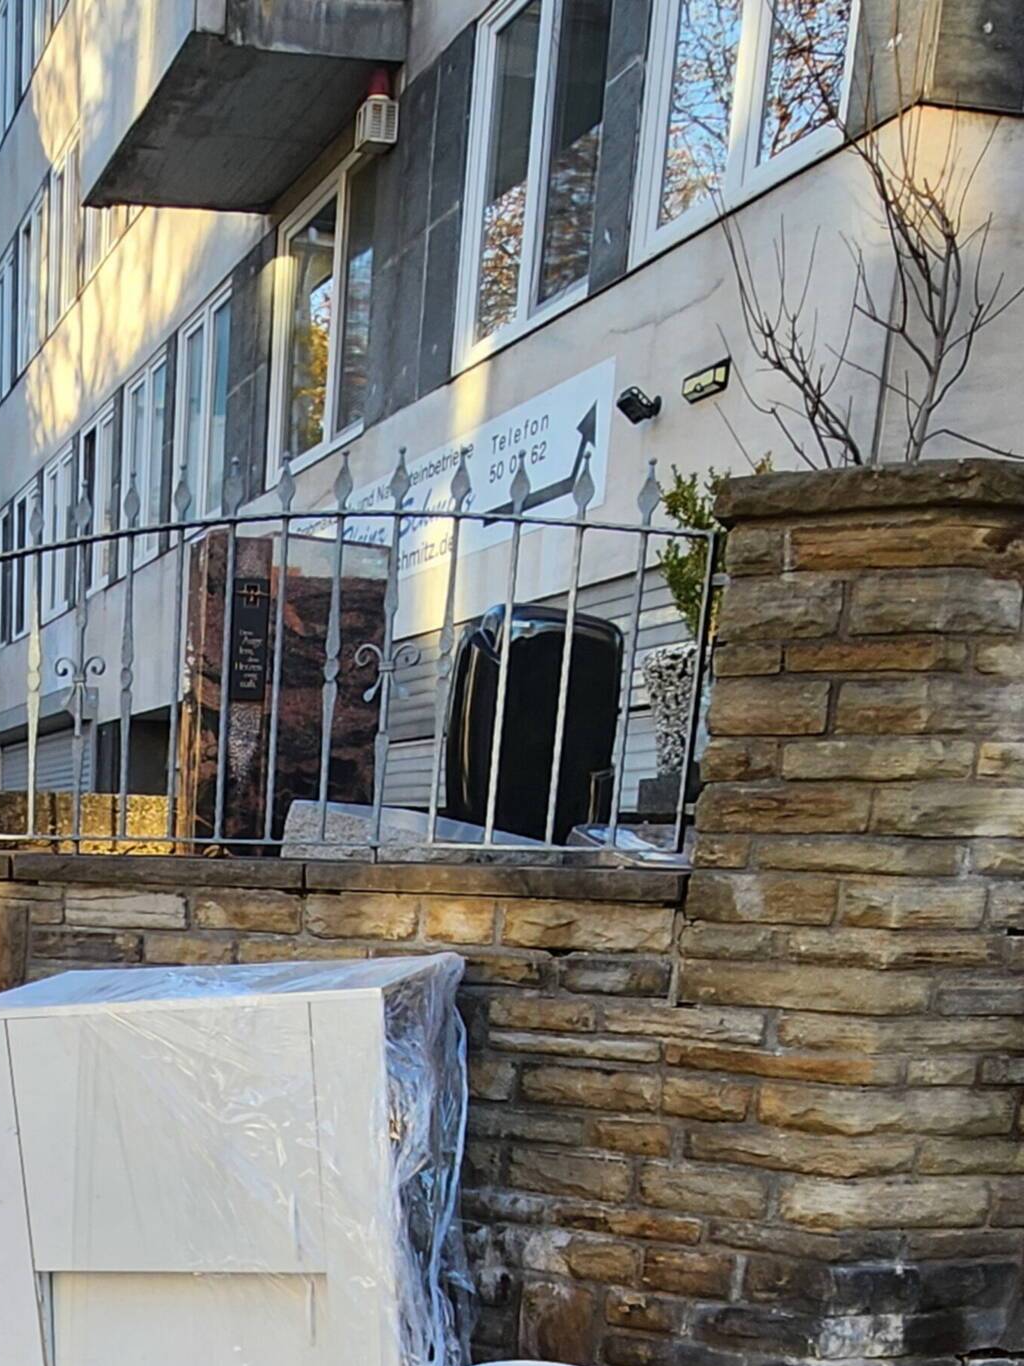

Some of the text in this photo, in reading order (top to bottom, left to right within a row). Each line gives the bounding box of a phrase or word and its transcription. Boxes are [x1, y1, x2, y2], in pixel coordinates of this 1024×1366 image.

[491, 414, 549, 455] Telefon
[489, 460, 504, 483] 50
[531, 440, 547, 464] 62
